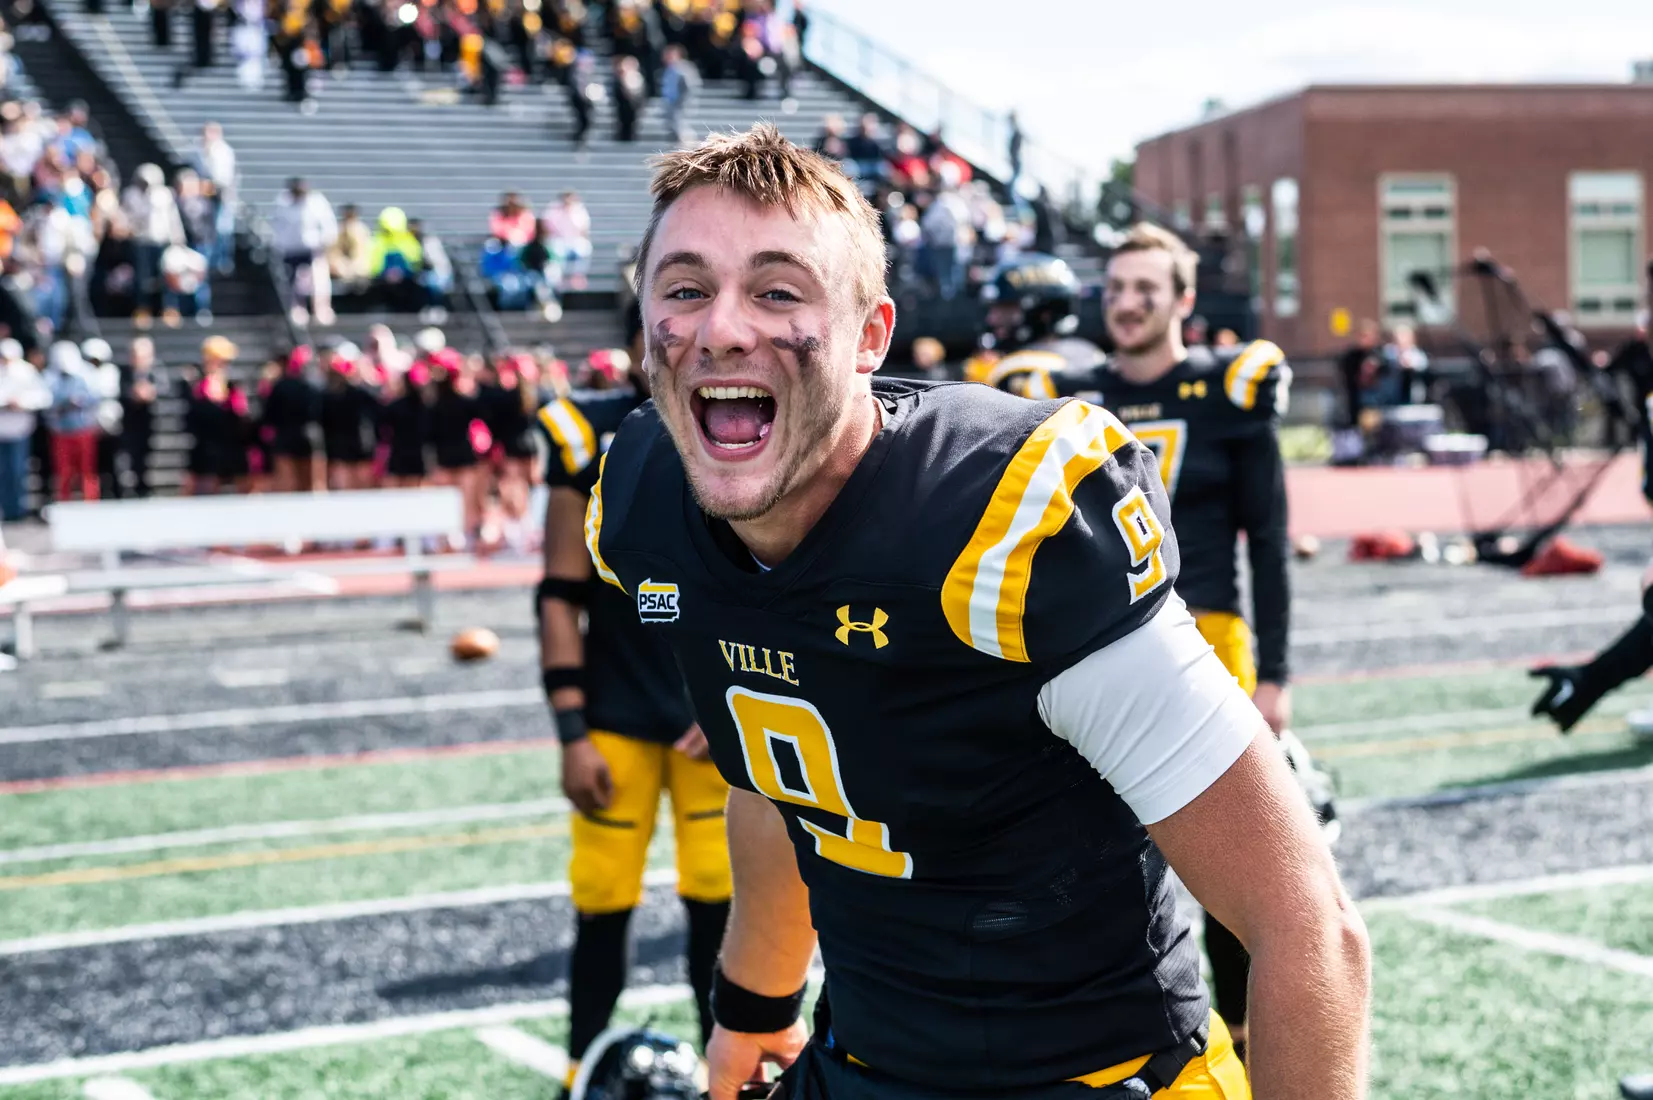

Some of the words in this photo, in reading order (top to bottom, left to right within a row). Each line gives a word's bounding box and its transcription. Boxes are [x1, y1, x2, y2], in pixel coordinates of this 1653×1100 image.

[1112, 486, 1167, 605] 9
[639, 593, 676, 610] PSAC
[718, 639, 799, 686] VILLE
[726, 685, 913, 879] 9
